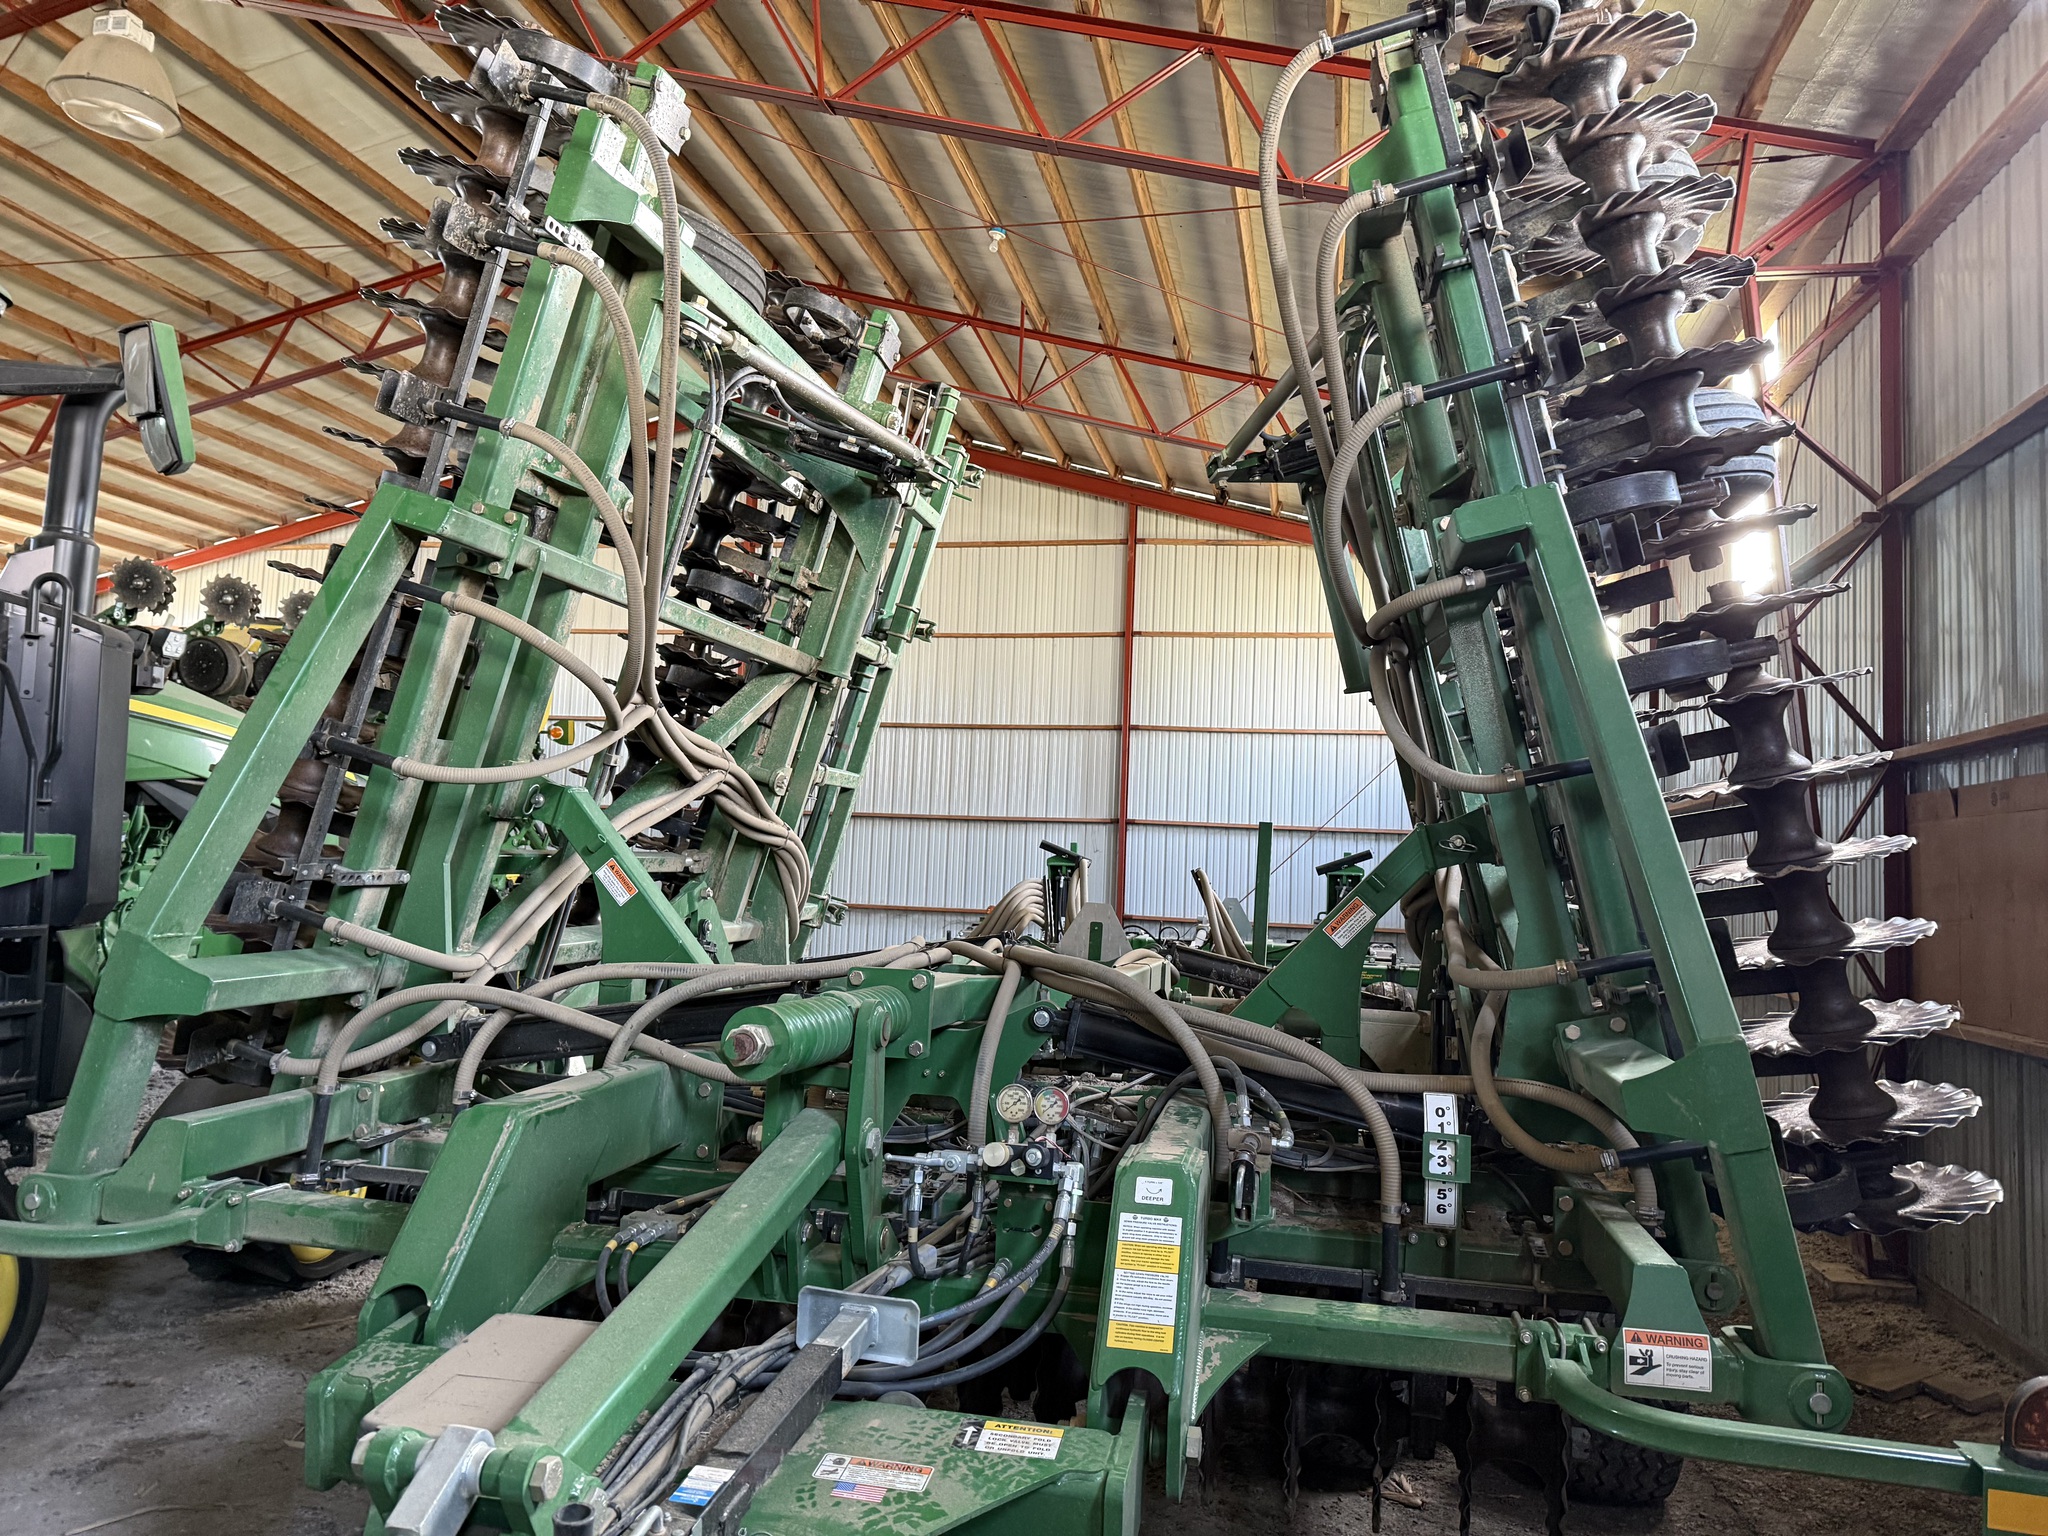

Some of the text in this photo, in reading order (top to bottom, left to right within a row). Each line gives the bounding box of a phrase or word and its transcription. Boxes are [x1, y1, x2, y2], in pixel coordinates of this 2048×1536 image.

[614, 869, 633, 892] WARNING
[1334, 902, 1359, 926] WARNING
[1646, 1334, 1704, 1347] WARNING
[994, 1424, 1053, 1434] ATTENTION:
[864, 1459, 922, 1474] WARNING
